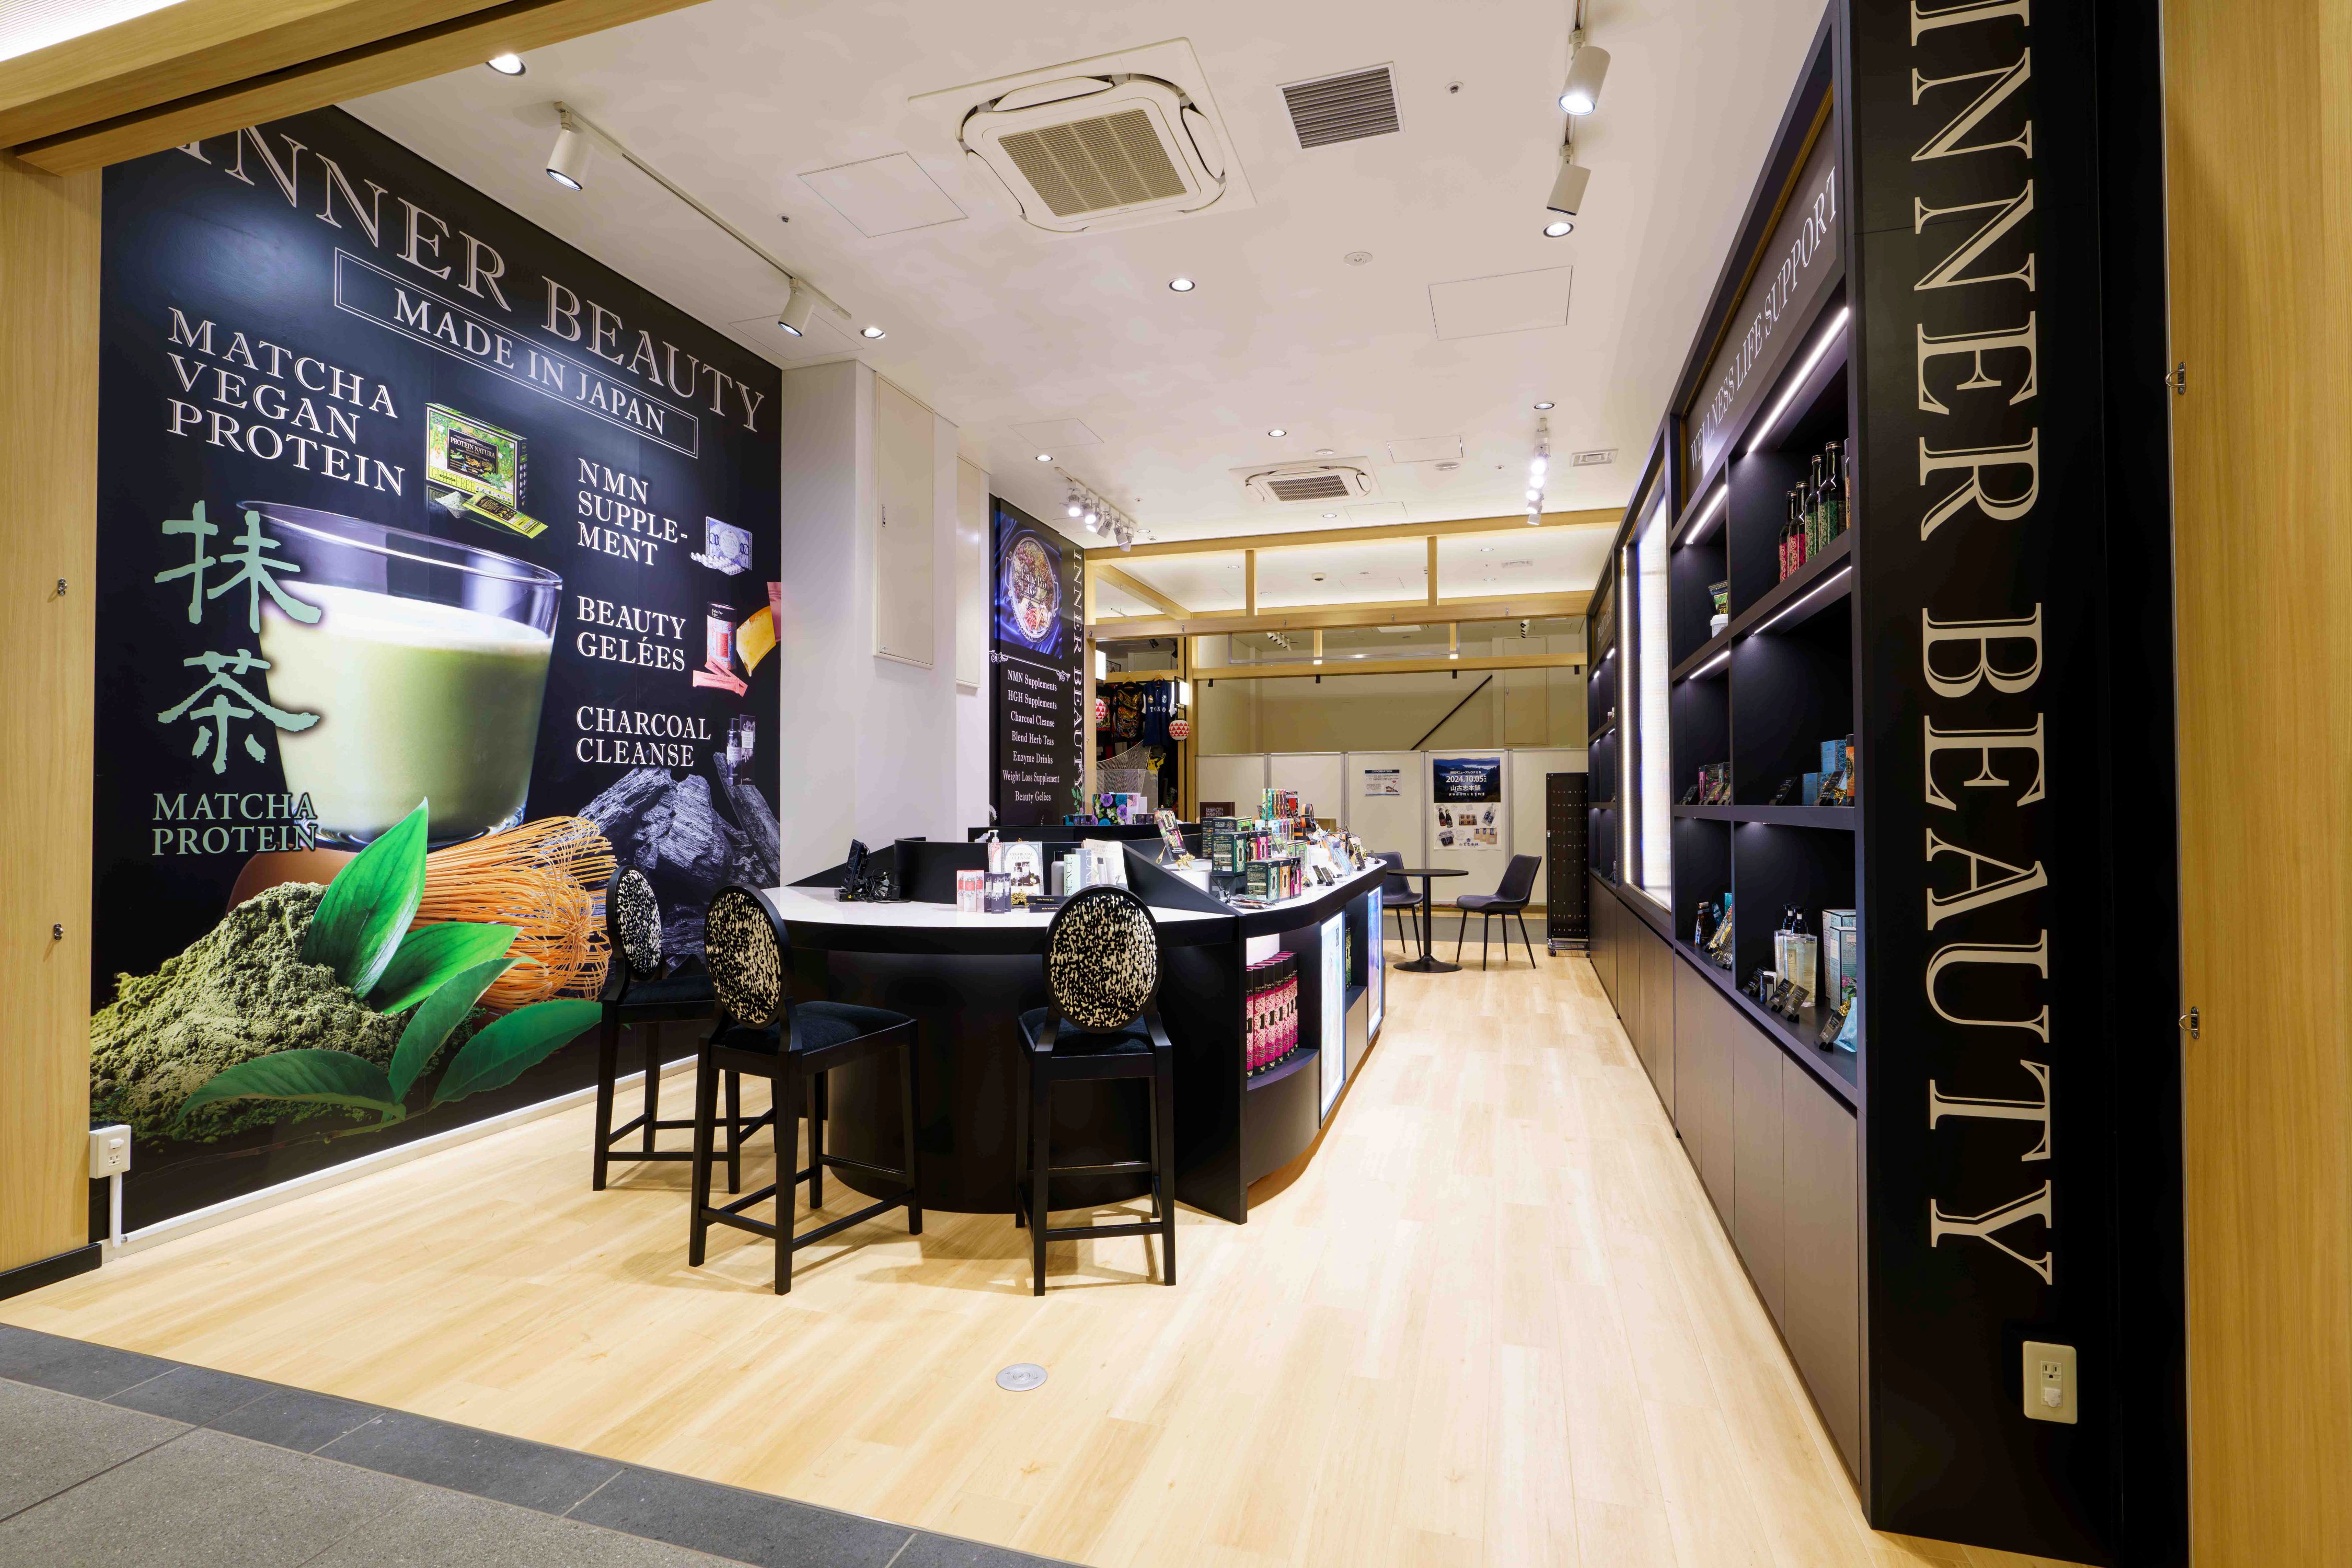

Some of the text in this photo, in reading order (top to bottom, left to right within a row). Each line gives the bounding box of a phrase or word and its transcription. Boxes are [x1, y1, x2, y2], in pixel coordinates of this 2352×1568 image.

[176, 125, 765, 432] NNER BEAUTY
[1690, 166, 1836, 470] WELLNESS LIFE SUPPORT
[168, 306, 398, 419] MATCHA
[394, 288, 665, 435] MADE IN JAPAN
[167, 352, 360, 444] VEGAN
[167, 398, 406, 496] PROTEIN
[450, 436, 495, 459] PROTEIN NATURA
[578, 458, 648, 504] NMN
[578, 490, 687, 543] SUPPLE-
[578, 521, 658, 566] MENT
[1021, 568, 1046, 589] Esthe Pro
[1021, 580, 1036, 595] Labo
[577, 595, 686, 640] BEAUTY
[154, 500, 322, 775] 抹茶
[577, 631, 685, 671] GELÉES
[1008, 669, 1057, 691] NMN Supplements
[1074, 549, 1082, 790] INNER BEAUTY
[1008, 689, 1057, 710] HGH Supplements
[576, 706, 711, 740] CHARCOAL
[1010, 710, 1055, 727] Charcoal Cleanse
[576, 738, 695, 767] CLEANSE
[1011, 731, 1054, 746] Blend Herb Teas
[1012, 751, 1053, 765] Enzyme Drinks
[1002, 770, 1059, 785] Weight Loss Supplement
[153, 793, 317, 821] MATCHA
[1015, 791, 1051, 804] Beauty Gelées
[152, 825, 317, 857] PROTEIN
[1922, 602, 2053, 1286] BEAUTY
